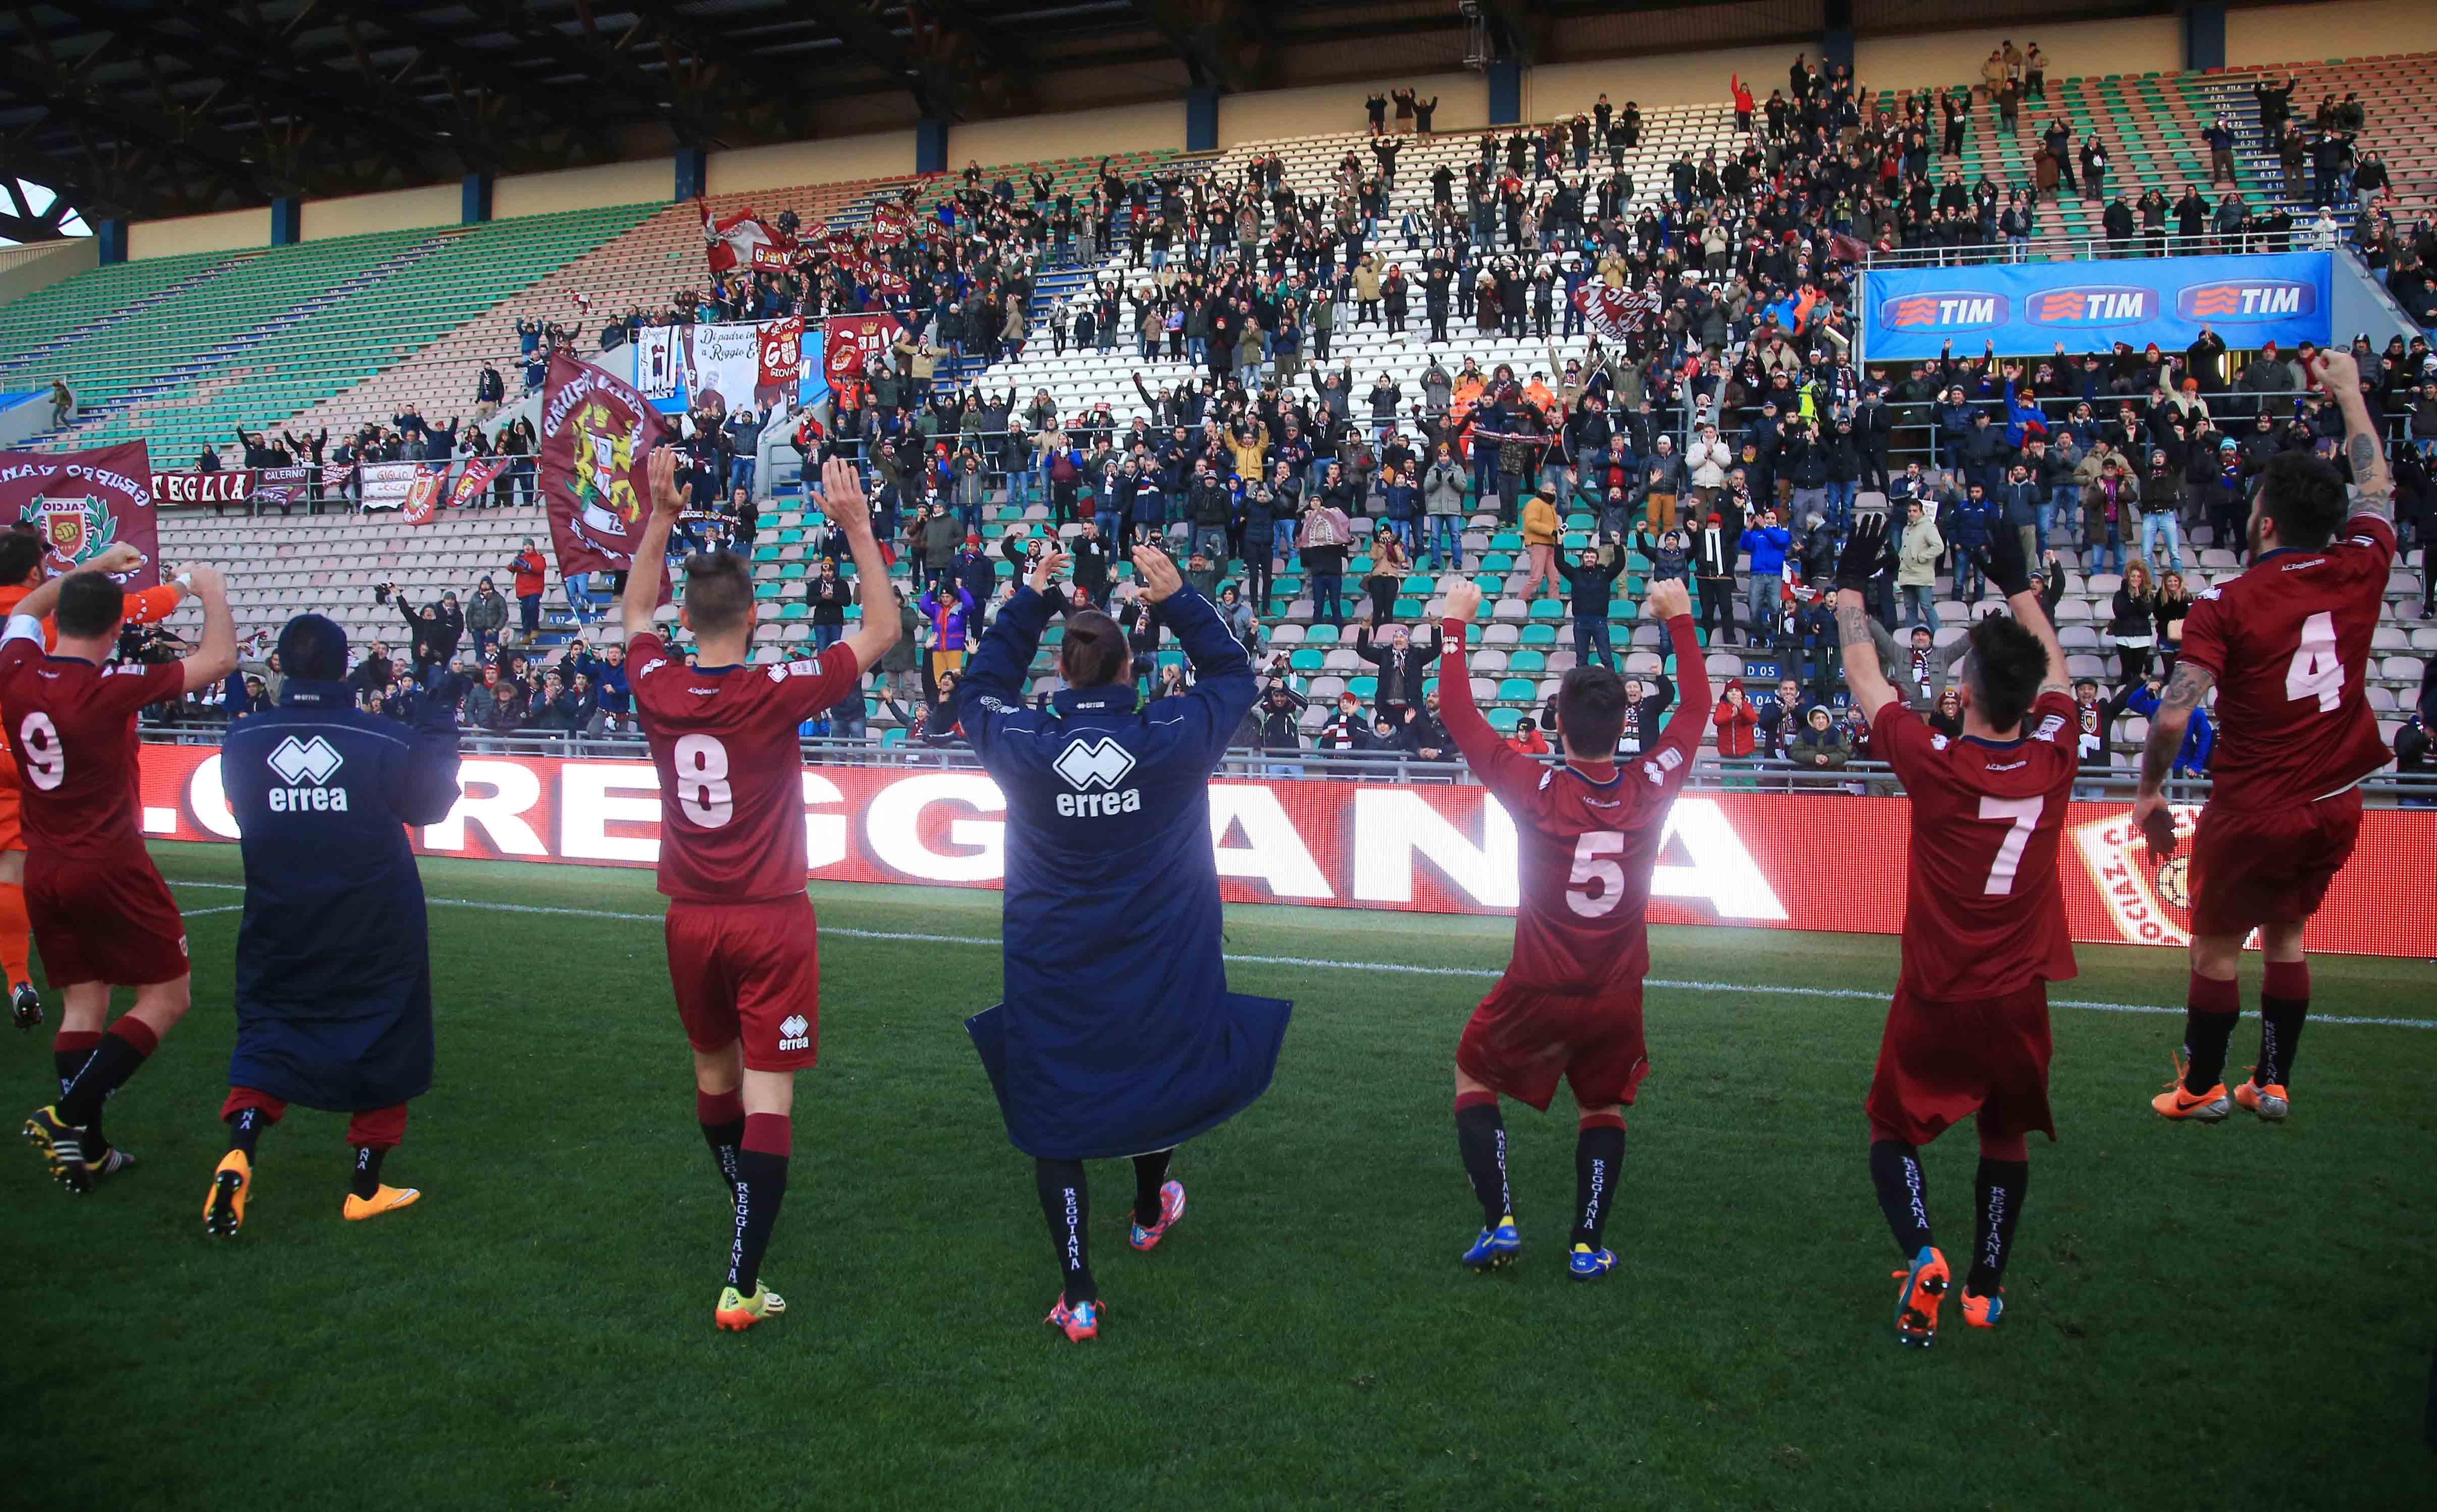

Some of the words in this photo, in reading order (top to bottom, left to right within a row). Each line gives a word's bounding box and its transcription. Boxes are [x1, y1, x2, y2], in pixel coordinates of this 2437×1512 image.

[1939, 298, 1995, 325] TIM
[2086, 293, 2143, 319] TIM
[2240, 288, 2301, 314] TIM
[709, 344, 745, 361] Reggio
[718, 331, 744, 342] padre
[265, 469, 306, 480] CALERNO
[1747, 666, 1755, 676] D
[1760, 666, 1775, 676] 05
[2286, 611, 2345, 713] 4
[21, 712, 65, 791] 9
[269, 787, 348, 812] errea
[674, 733, 733, 828] 8
[1056, 788, 1141, 818] errea
[1977, 796, 2045, 896] 7
[1566, 831, 1624, 917] 5
[779, 1036, 809, 1050] errea
[1495, 1129, 1511, 1214] REGGIANA
[1583, 1159, 1605, 1229] REGGIANA
[728, 1182, 750, 1284] REGGIANA
[1063, 1187, 1081, 1270] REGGIANA
[1983, 1186, 2006, 1268] REGGIANA
